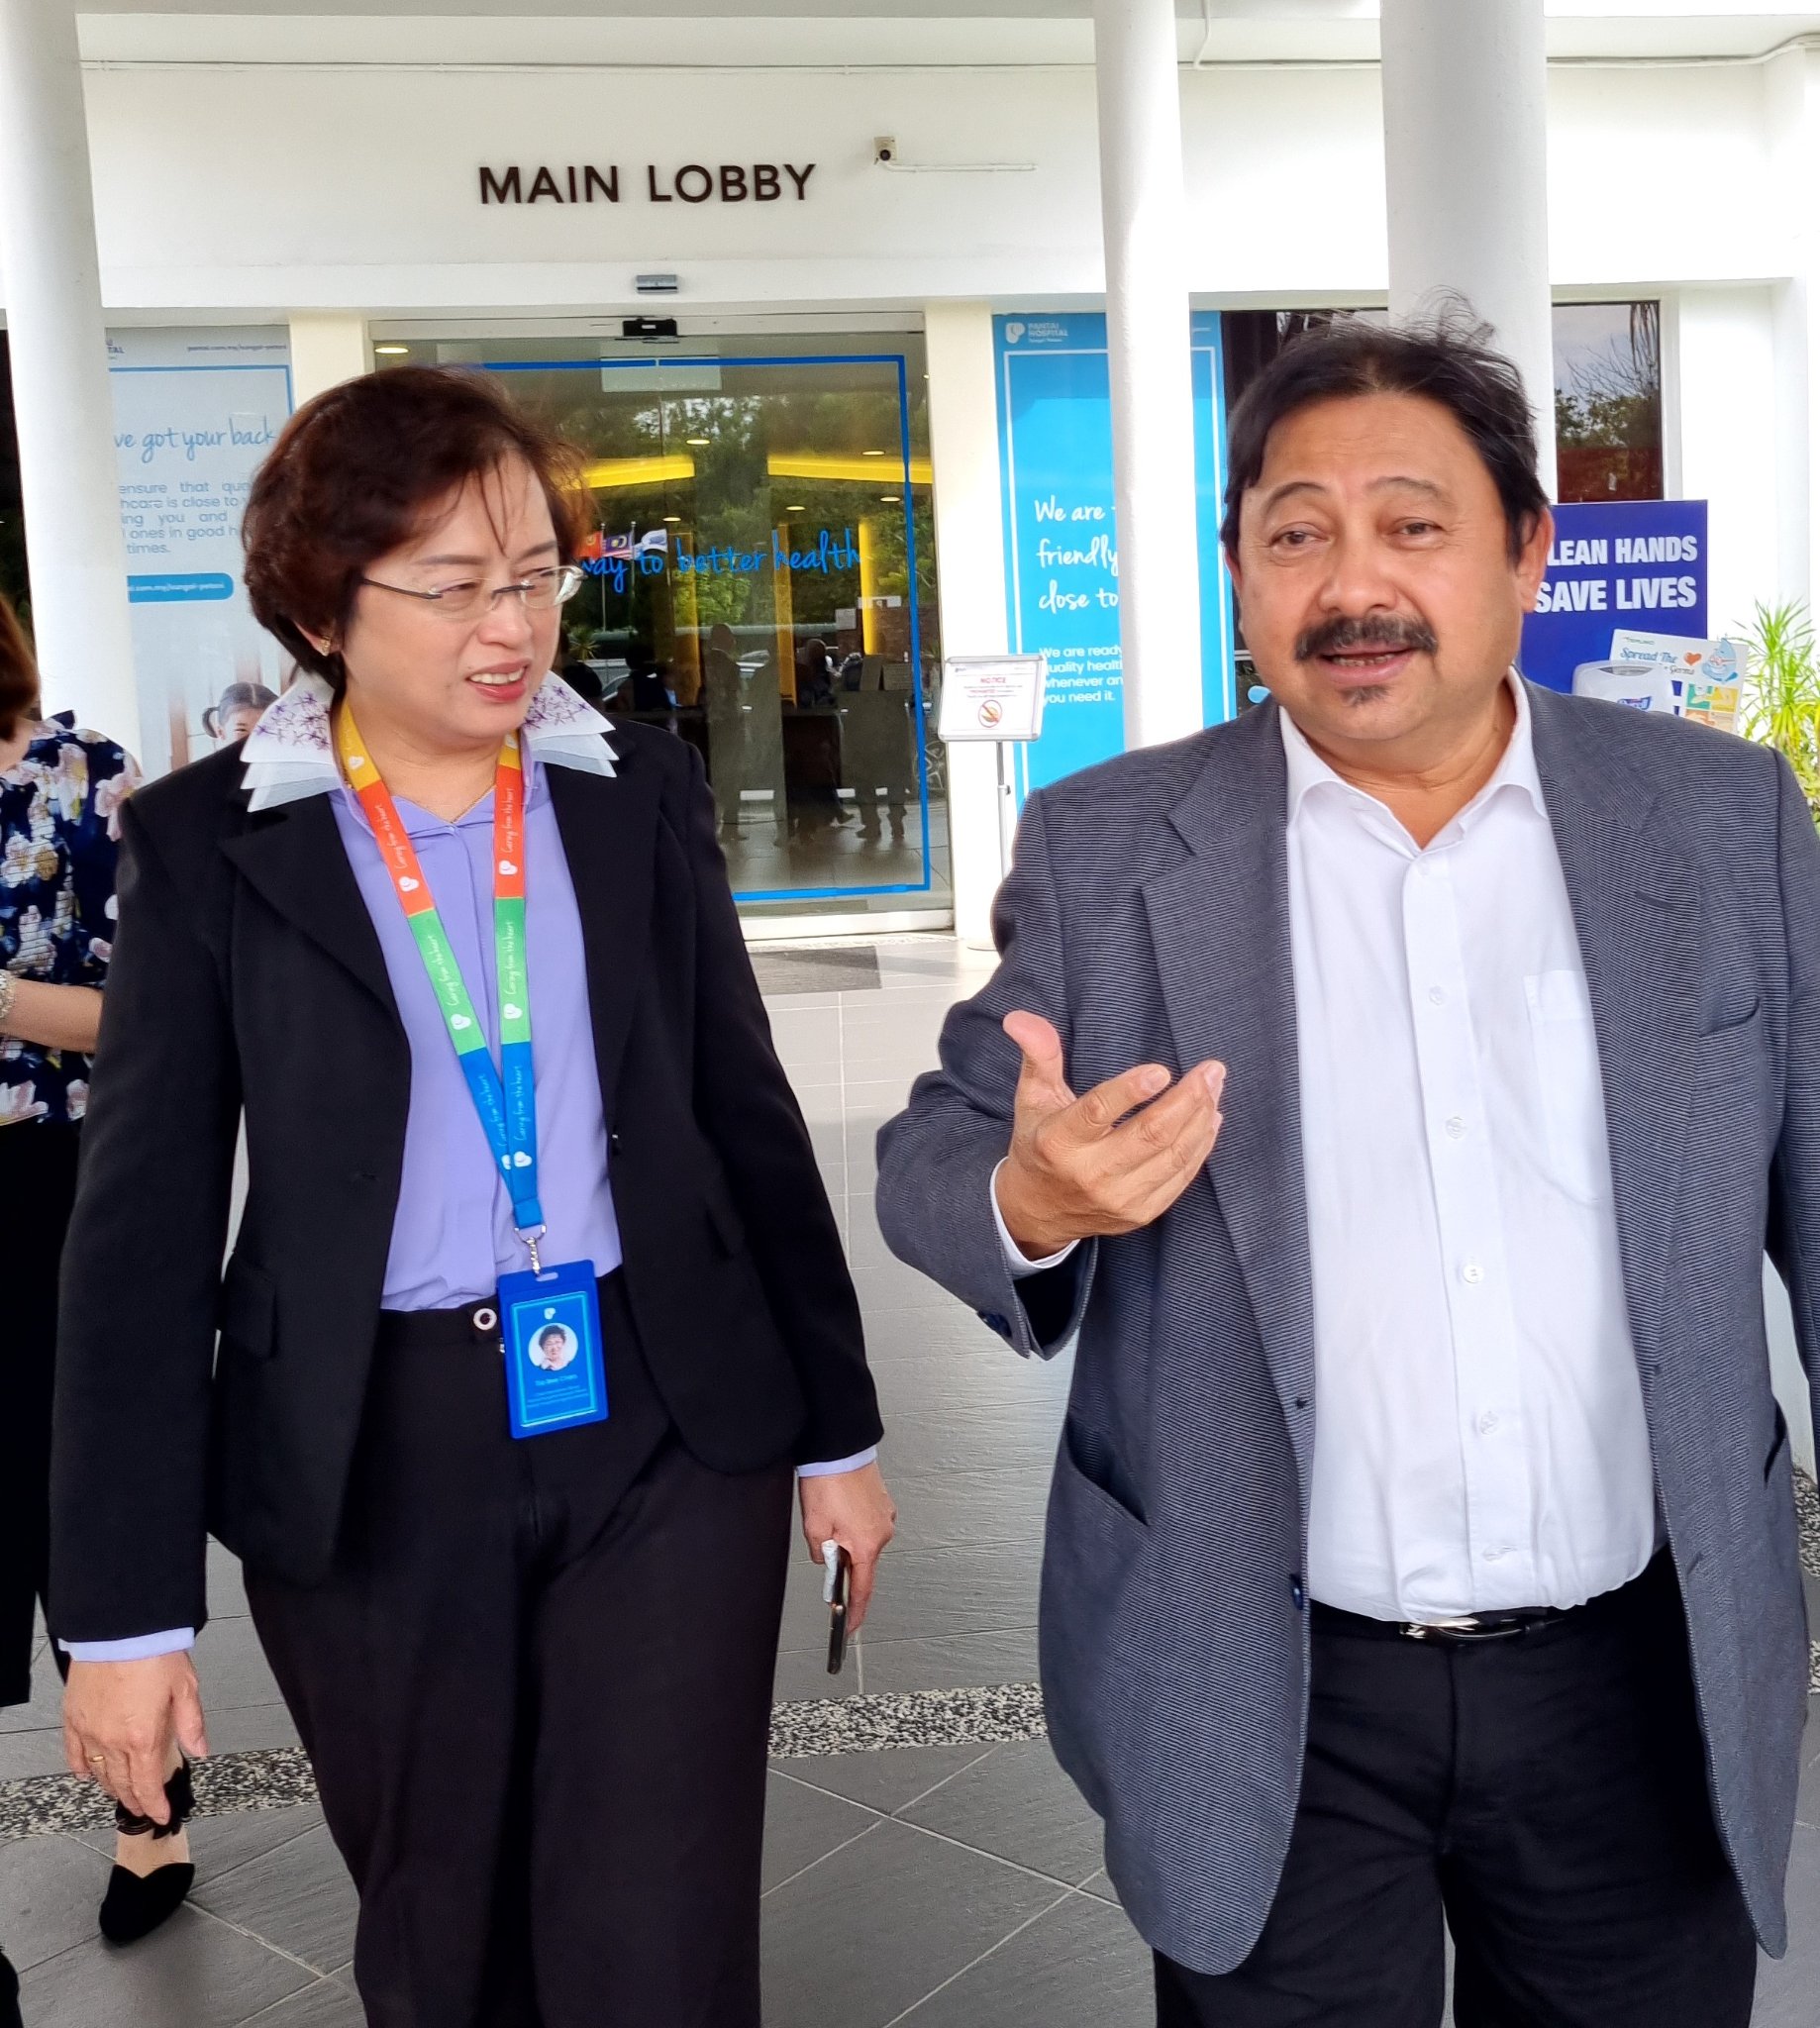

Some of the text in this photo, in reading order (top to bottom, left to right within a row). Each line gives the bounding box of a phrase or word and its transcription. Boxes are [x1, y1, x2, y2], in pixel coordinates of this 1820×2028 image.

[478, 163, 816, 205] MAIN LOBBY
[142, 427, 179, 463] got
[182, 430, 228, 461] your
[229, 414, 277, 446] back
[179, 481, 209, 493] that
[166, 496, 178, 508] is
[181, 496, 221, 508] close
[224, 496, 239, 507] to
[1034, 495, 1106, 523] We are
[157, 513, 186, 526] you
[199, 510, 228, 523] and
[130, 529, 166, 540] ones
[169, 525, 183, 539] in
[186, 525, 226, 541] good
[636, 551, 664, 575] to
[676, 536, 767, 575] better
[771, 527, 860, 574] health
[1036, 534, 1119, 577] friendly
[1615, 535, 1698, 564] HANDS
[1039, 579, 1118, 614] close to
[1535, 576, 1698, 614] SAVE LIVES
[1039, 648, 1061, 659] We
[1062, 647, 1085, 658] are
[1068, 690, 1102, 702] need
